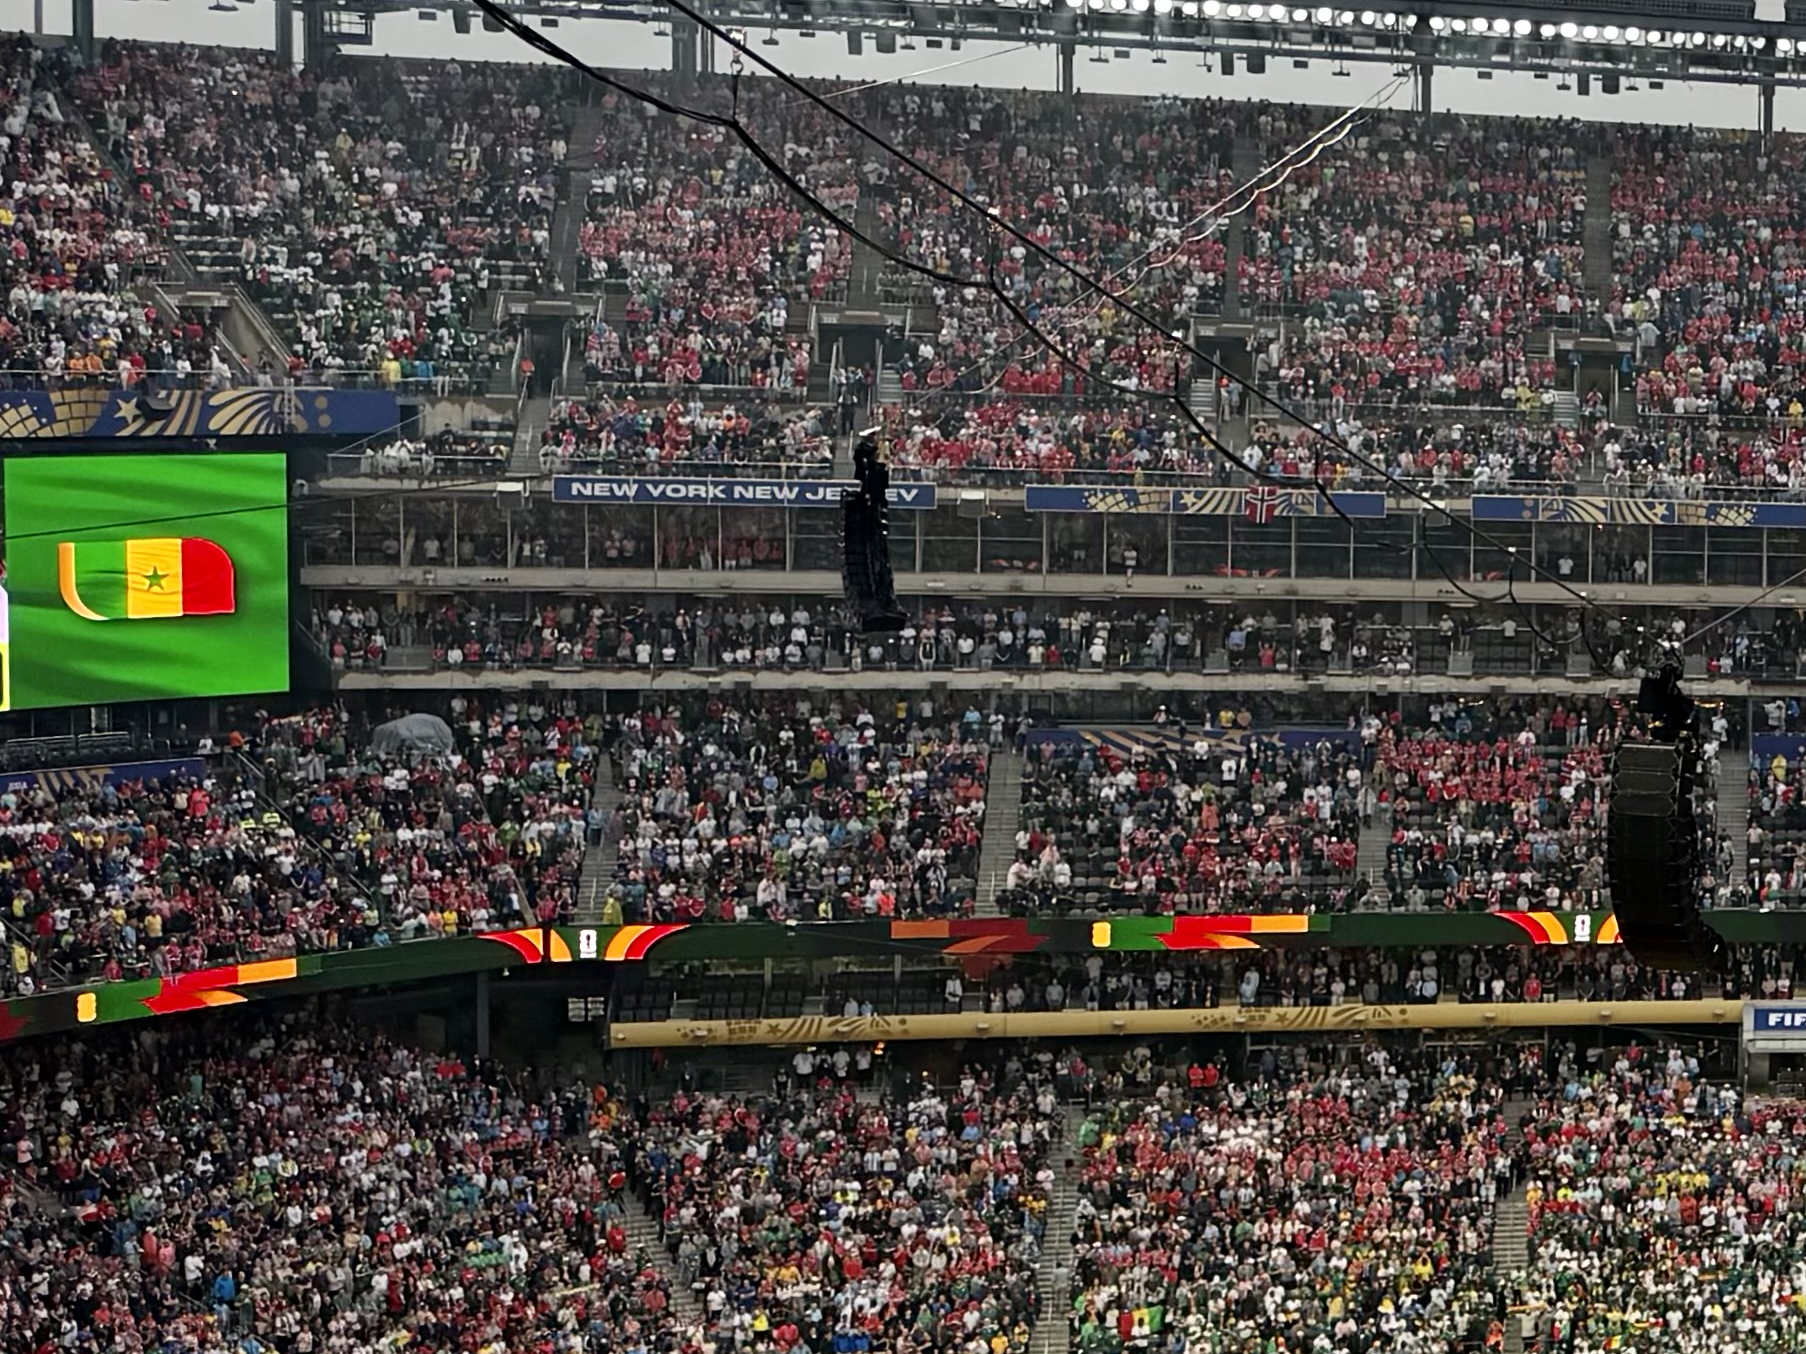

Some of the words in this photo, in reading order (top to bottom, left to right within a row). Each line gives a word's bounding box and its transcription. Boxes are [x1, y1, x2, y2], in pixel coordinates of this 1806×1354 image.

[571, 482, 637, 498] NEW
[645, 483, 726, 499] YORK
[734, 485, 799, 500] NEW
[806, 486, 919, 502] JEEY
